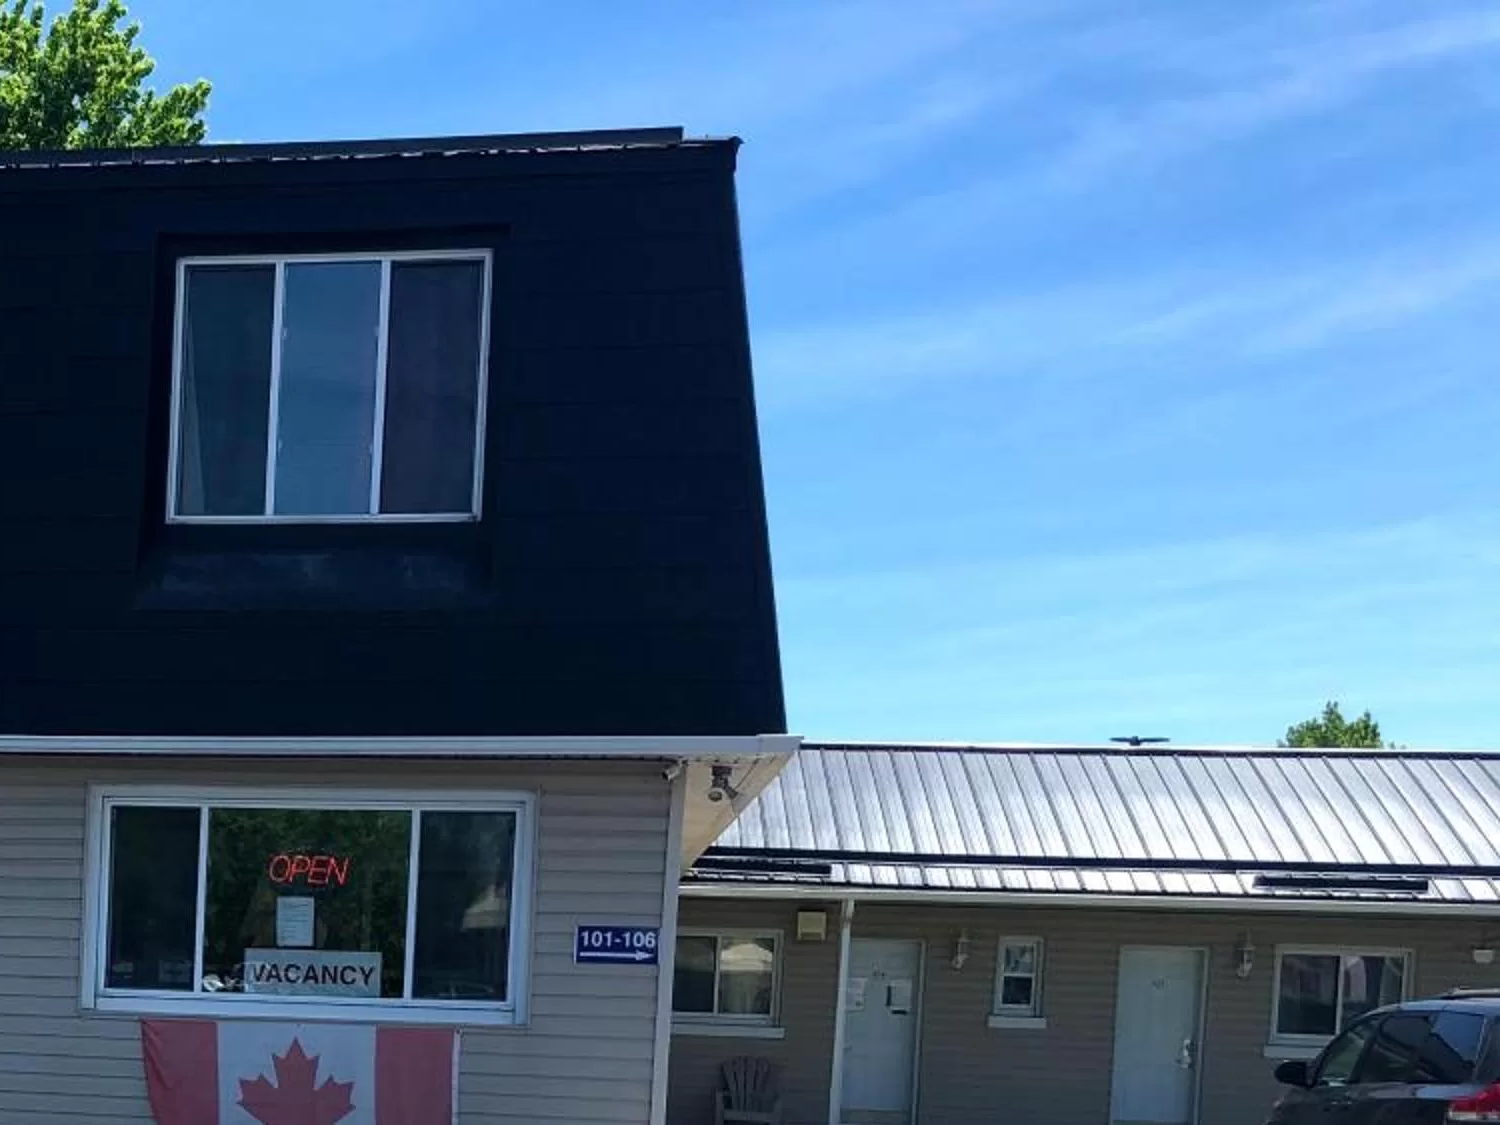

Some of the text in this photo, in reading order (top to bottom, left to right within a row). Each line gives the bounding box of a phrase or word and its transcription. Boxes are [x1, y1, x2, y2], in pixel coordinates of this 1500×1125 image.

[269, 855, 349, 885] OPEN
[581, 930, 656, 949] 101-106
[254, 964, 374, 985] VACANCY
